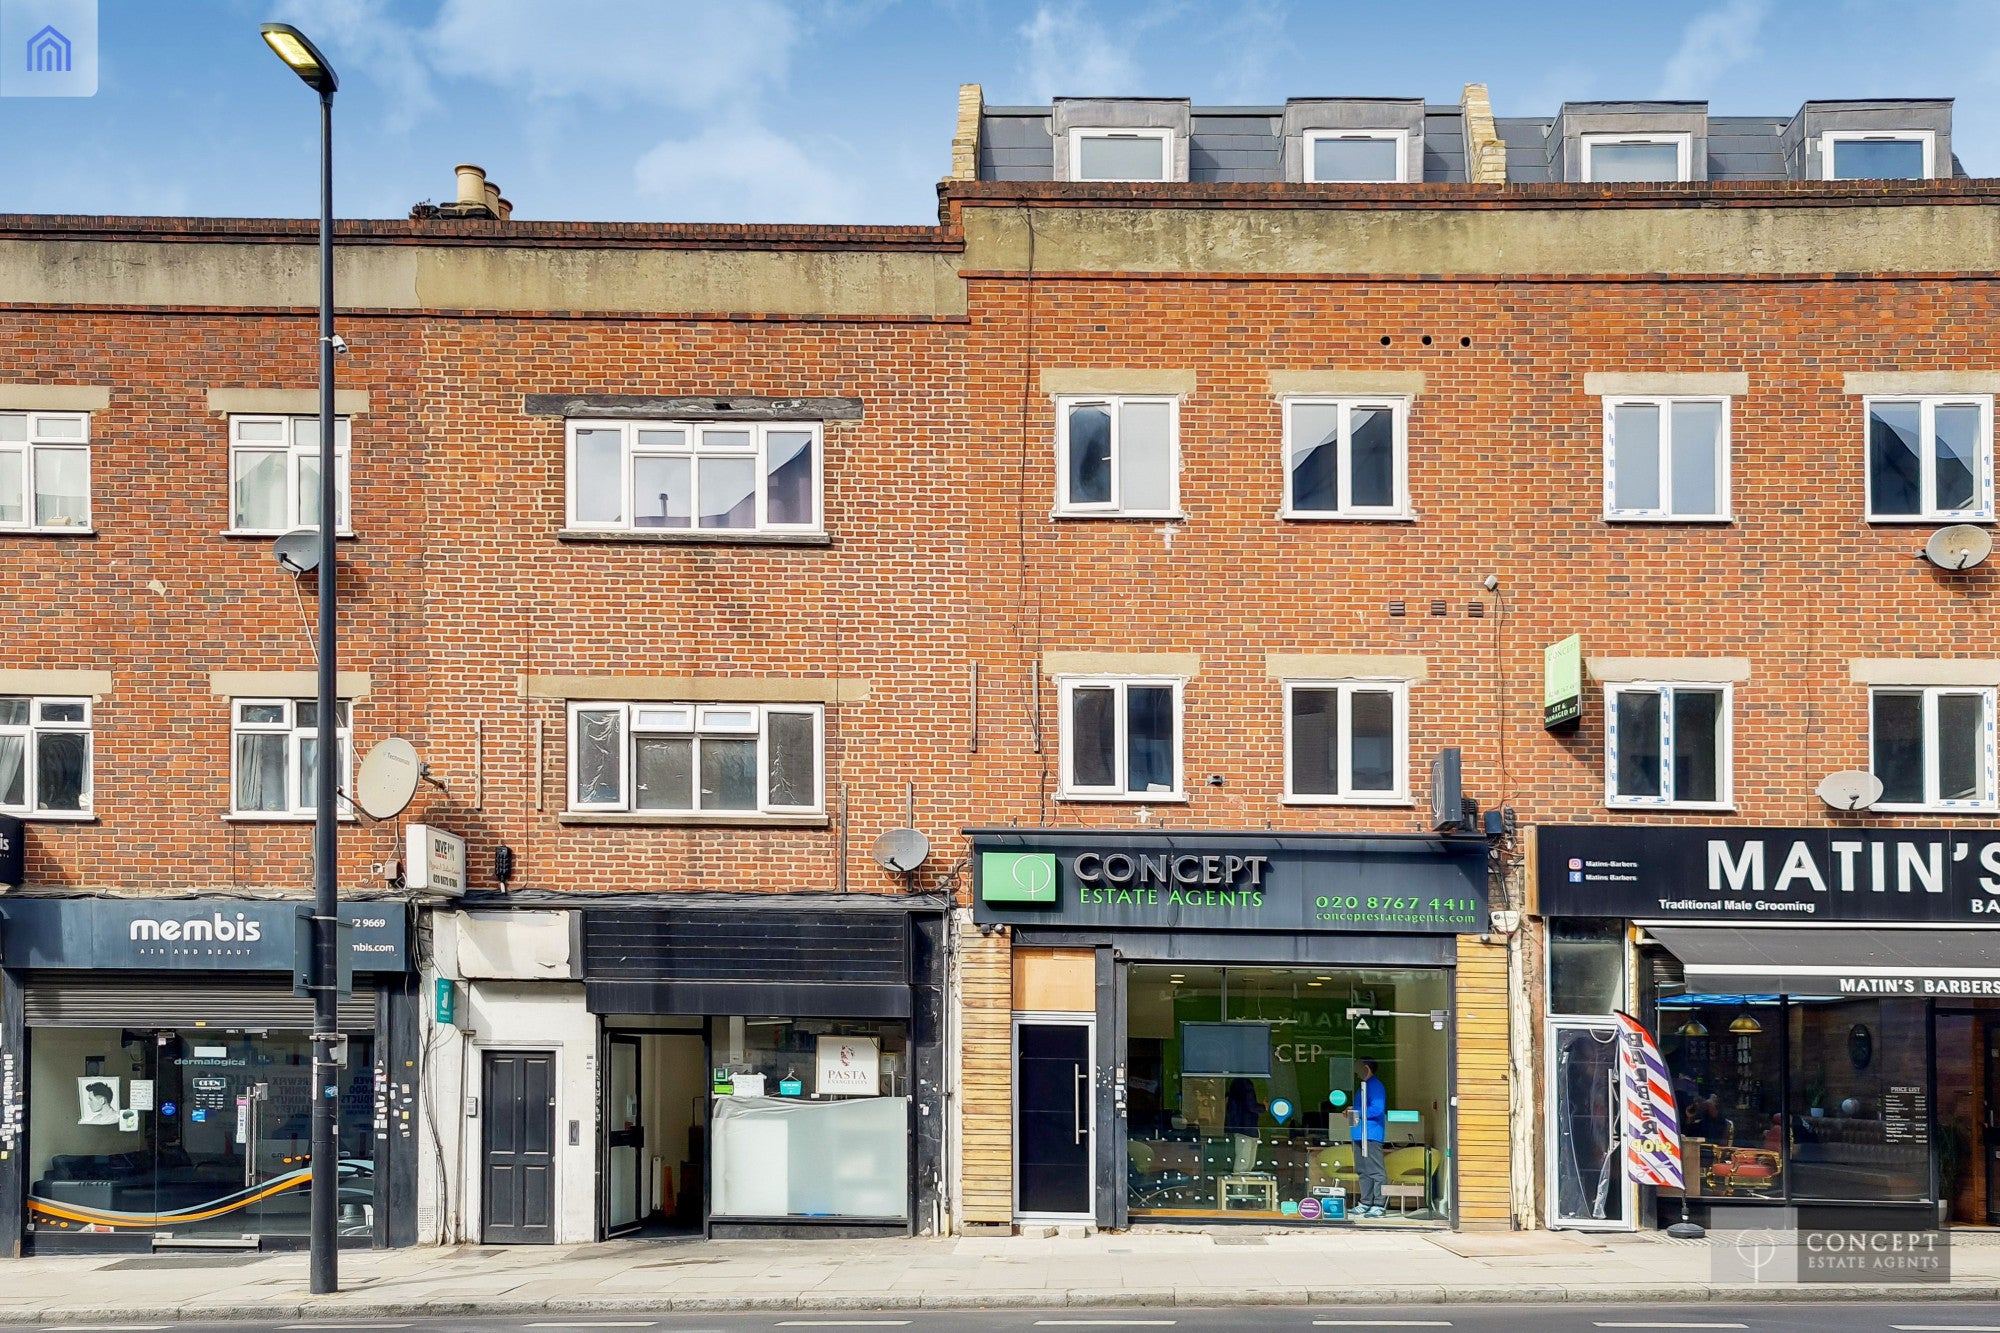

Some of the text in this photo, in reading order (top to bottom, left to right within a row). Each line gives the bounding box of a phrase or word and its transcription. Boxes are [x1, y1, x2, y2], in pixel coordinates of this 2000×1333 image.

[1073, 852, 1268, 885] CONCEPT
[1080, 888, 1263, 907] ESTATE AGENTS
[1315, 896, 1476, 911] 020 8767 4411
[1658, 898, 1815, 913] Traditional Male Grooming
[362, 918, 386, 928] 9669
[1315, 912, 1476, 924] conceptestateagents.com
[130, 913, 262, 941] membis
[1839, 978, 2000, 994] MATIN'S BARBERS
[174, 1058, 246, 1066] dermalogica
[828, 1070, 867, 1079] PASTA
